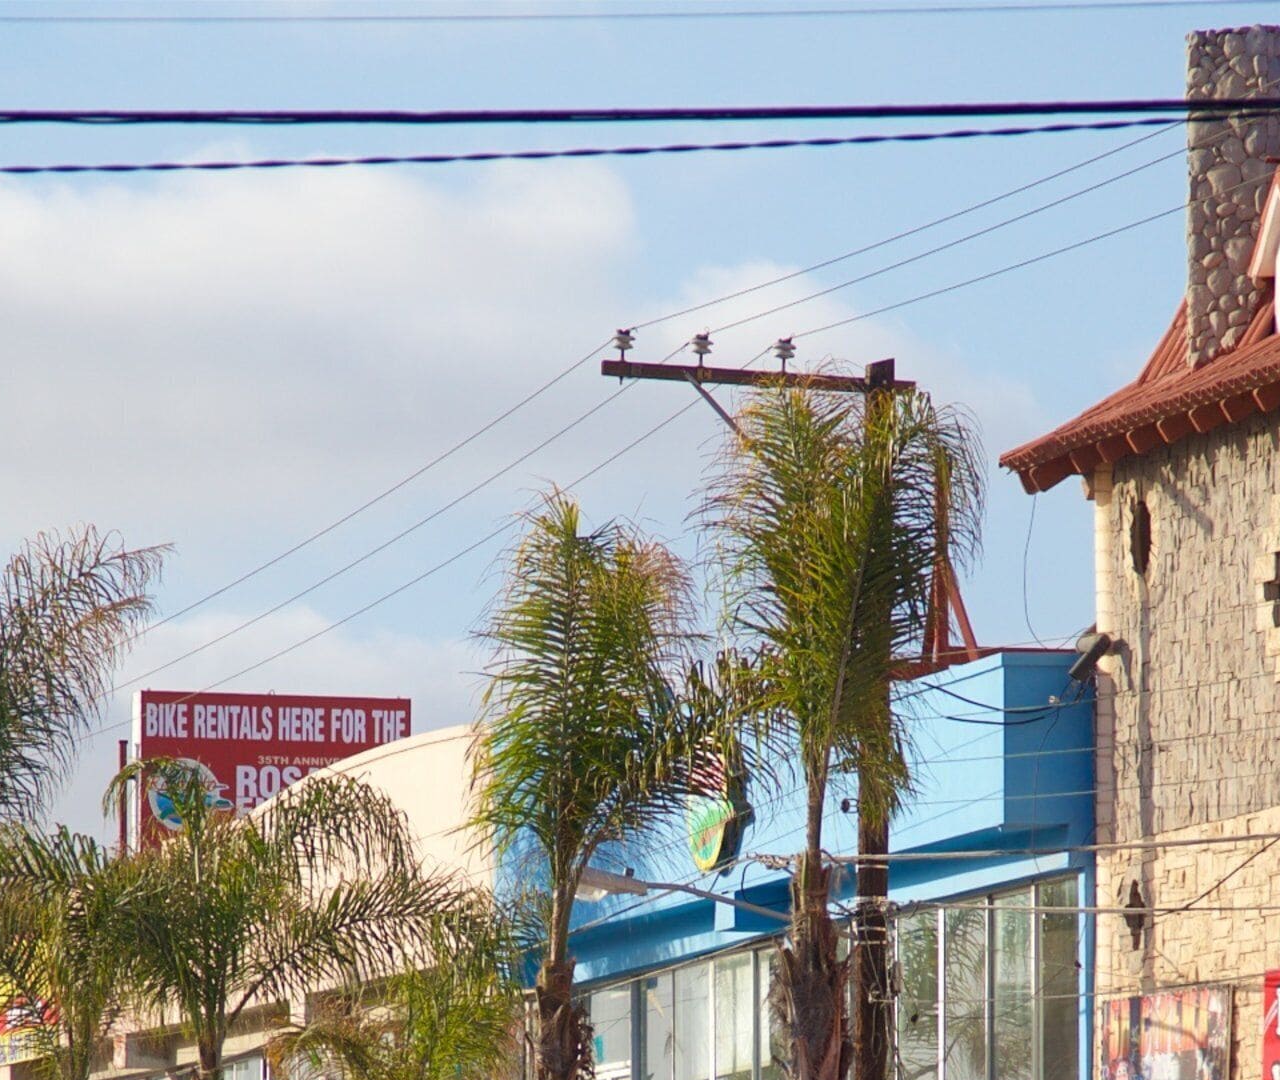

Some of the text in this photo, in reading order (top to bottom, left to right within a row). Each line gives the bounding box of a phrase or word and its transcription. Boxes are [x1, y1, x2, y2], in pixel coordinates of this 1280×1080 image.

[145, 702, 406, 744] BIKE RENTALS HERE FOR THE
[257, 755, 344, 767] 35TH ANNIVE
